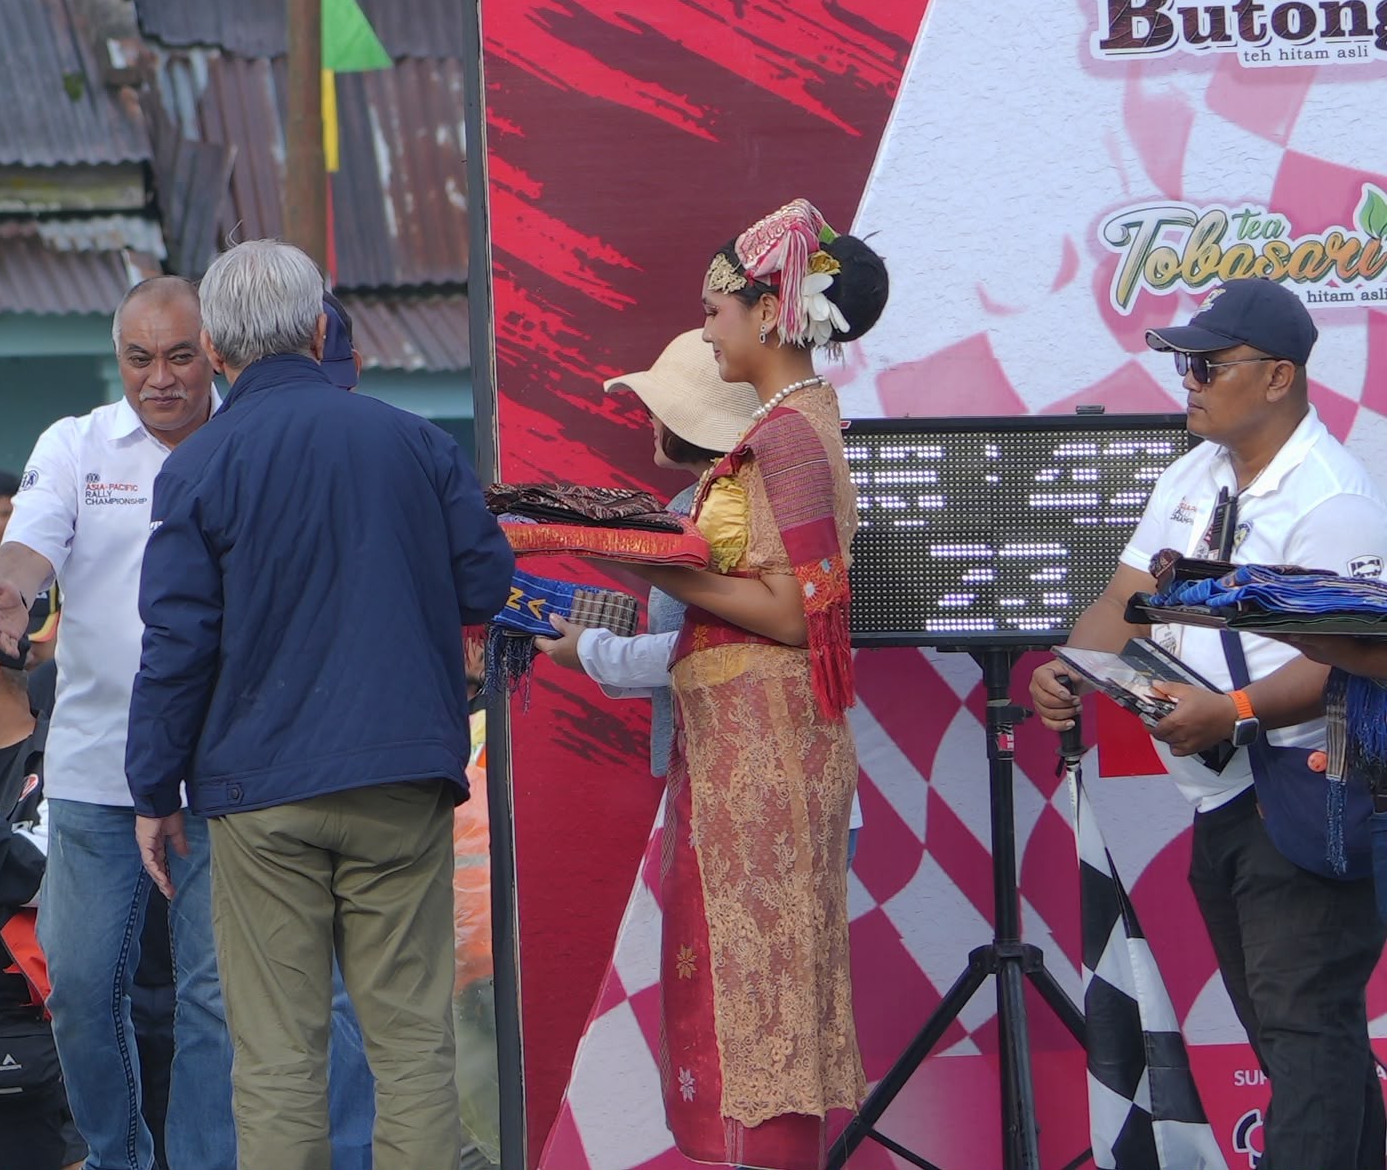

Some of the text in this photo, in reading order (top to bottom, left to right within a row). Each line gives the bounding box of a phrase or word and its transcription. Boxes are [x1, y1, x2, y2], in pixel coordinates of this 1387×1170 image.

[1243, 45, 1369, 62] teh hitam asli
[1232, 207, 1285, 242] tea
[1307, 290, 1354, 303] hitam
[85, 497, 148, 506] CHAMPIONSHIP
